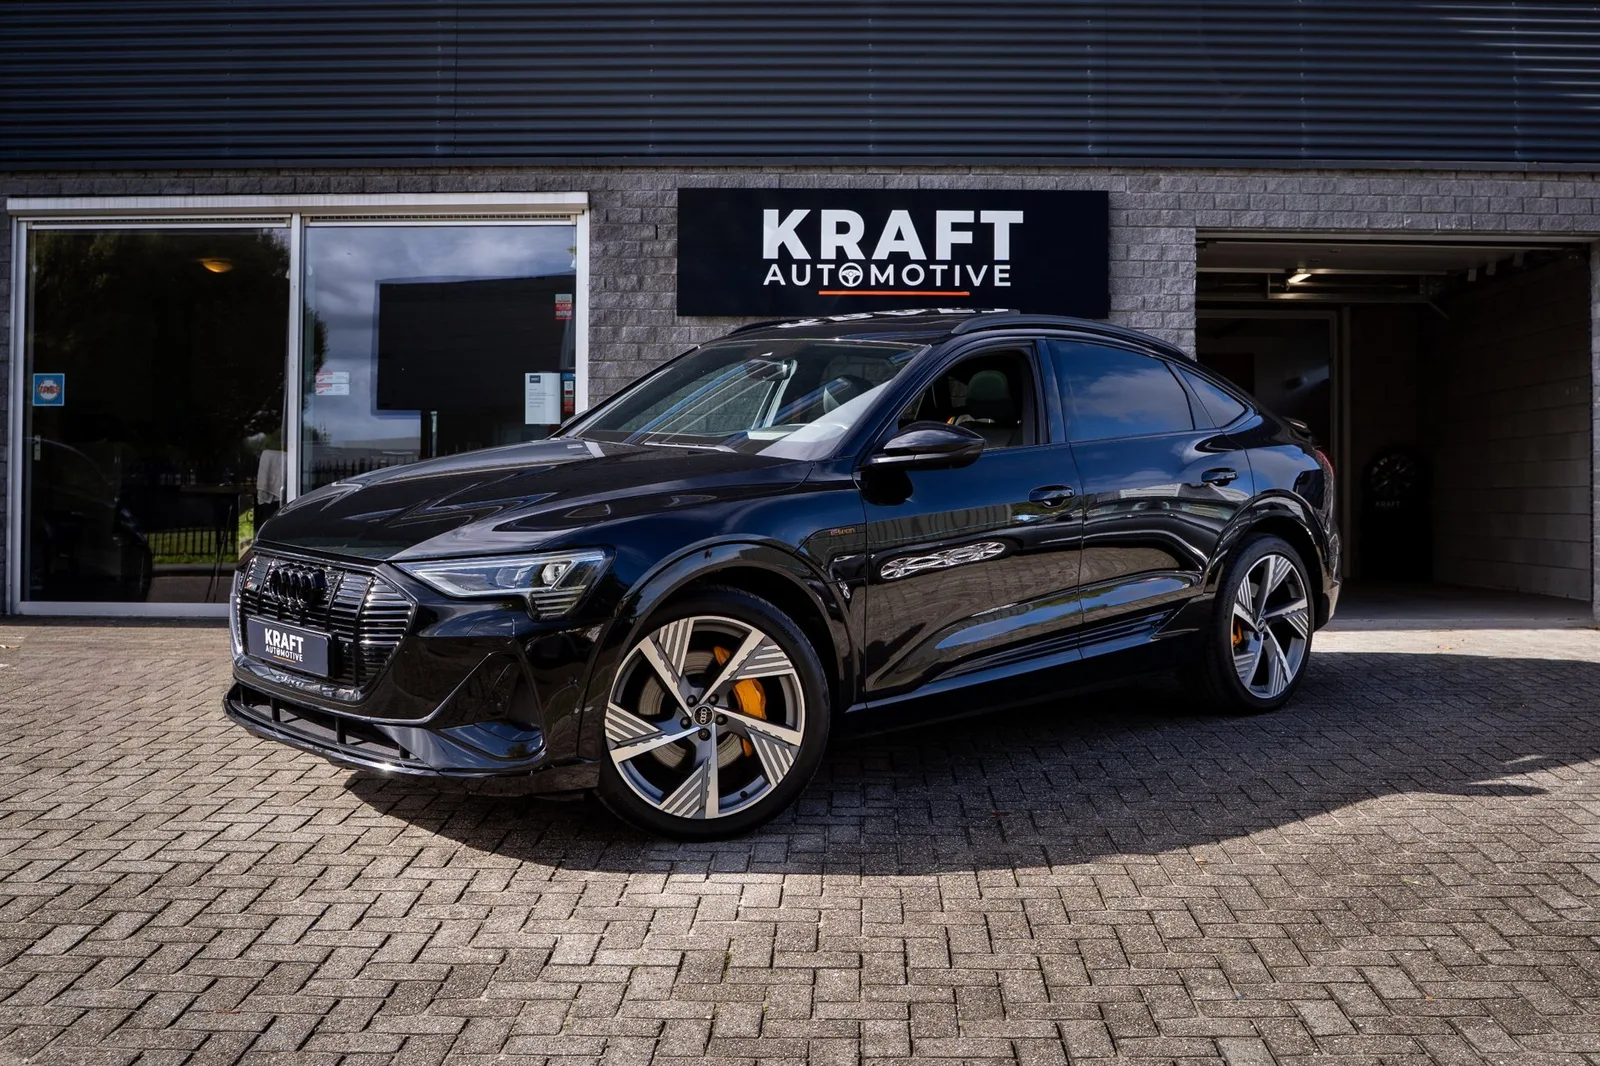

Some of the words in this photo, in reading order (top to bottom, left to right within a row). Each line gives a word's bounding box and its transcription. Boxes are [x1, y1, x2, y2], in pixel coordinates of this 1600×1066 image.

[763, 209, 1024, 260] KRAFT
[763, 262, 1011, 287] AUTOMOTIVE
[265, 628, 304, 654] KRAFT
[265, 646, 303, 662] AUTOMOTIVE
